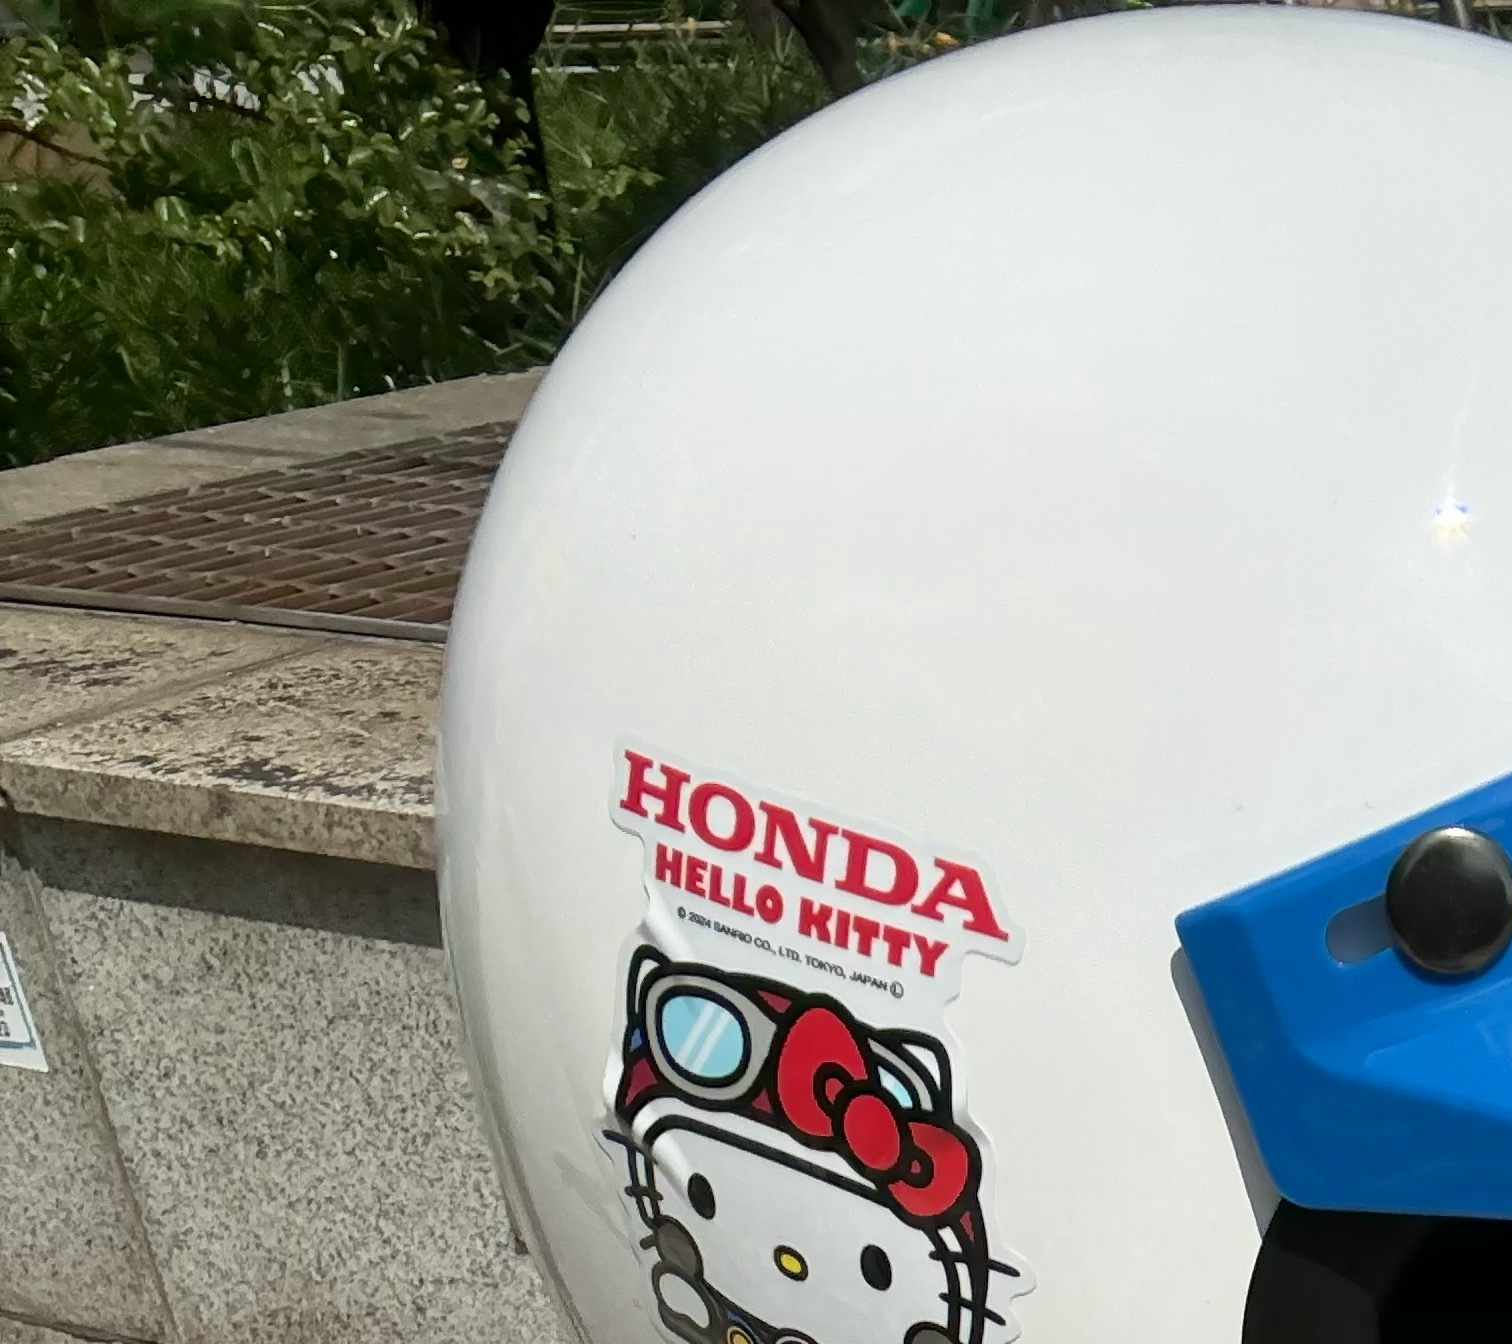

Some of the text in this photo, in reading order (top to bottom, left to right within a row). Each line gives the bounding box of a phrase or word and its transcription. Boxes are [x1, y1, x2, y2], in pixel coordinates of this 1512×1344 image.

[620, 749, 1009, 942] HONDA
[655, 843, 949, 977] HELLO KITTY
[713, 920, 753, 945] SANRIO
[804, 954, 847, 979] TOKYO,
[848, 971, 888, 991] JAPAN
